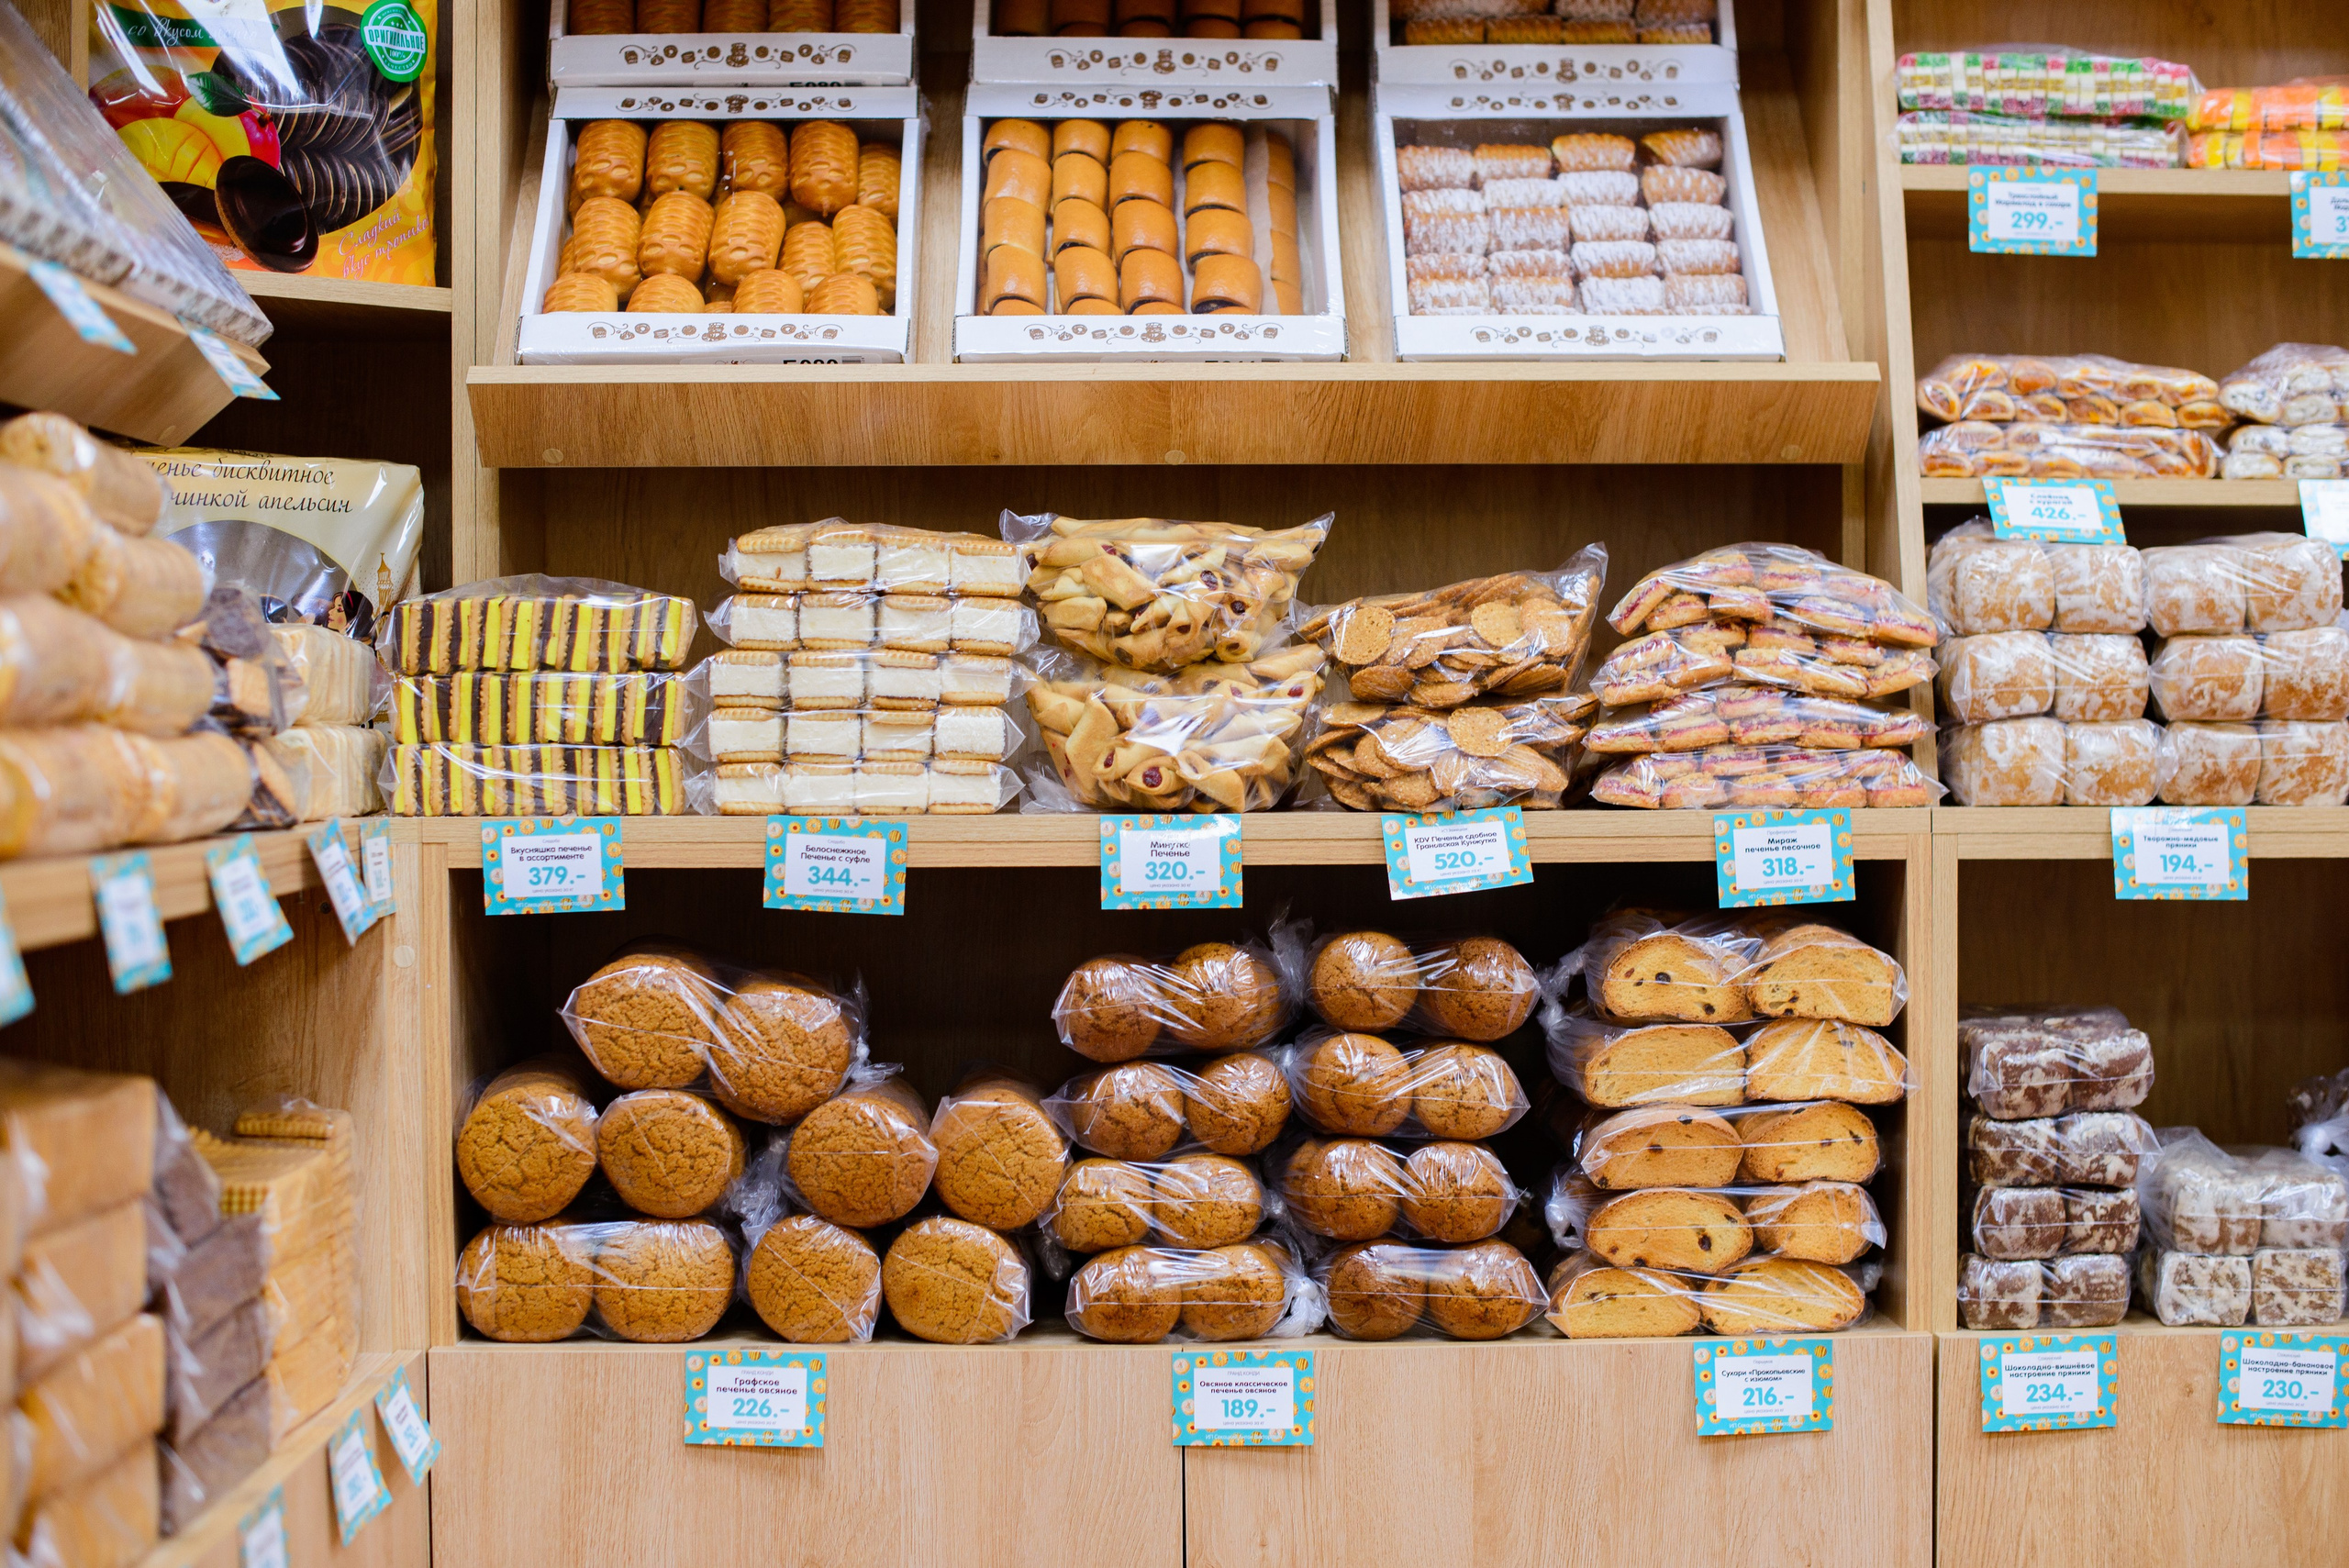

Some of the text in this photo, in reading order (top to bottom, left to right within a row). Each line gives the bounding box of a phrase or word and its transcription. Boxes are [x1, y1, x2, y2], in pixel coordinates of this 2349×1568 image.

[128, 26, 147, 36] со
[153, 17, 204, 46] вкусом
[368, 29, 423, 50] ОРИГИНАЛЬНОЕ
[390, 50, 406, 58] 100%
[2011, 211, 2063, 229] 299.-
[339, 208, 402, 255] Сладкий
[343, 254, 370, 280] вкус
[213, 457, 335, 484] бисквитное
[169, 489, 353, 513] чинкой апельсин
[2032, 507, 2087, 520] 426.-
[806, 845, 866, 854] Белоснежное
[1461, 838, 1497, 847] Кунжутка
[801, 852, 836, 861] Печенье
[1434, 851, 1494, 870] 520.-
[1762, 856, 1815, 877] 318.-
[2160, 854, 2213, 873] 194.-
[529, 865, 585, 885] 379.-
[807, 865, 871, 887] 344.-
[1145, 861, 1206, 881] 320.-
[2005, 1362, 2095, 1371] Шоколадно-вишнёвое
[2243, 1359, 2333, 1369] Шоколадно-банановое
[734, 1377, 780, 1386] Графское
[2263, 1379, 2319, 1400] 230.-
[1742, 1386, 1794, 1407] 216.-
[2026, 1384, 2084, 1403] 234.-
[732, 1397, 789, 1418] 226.-
[1221, 1398, 1275, 1418] 189.-
